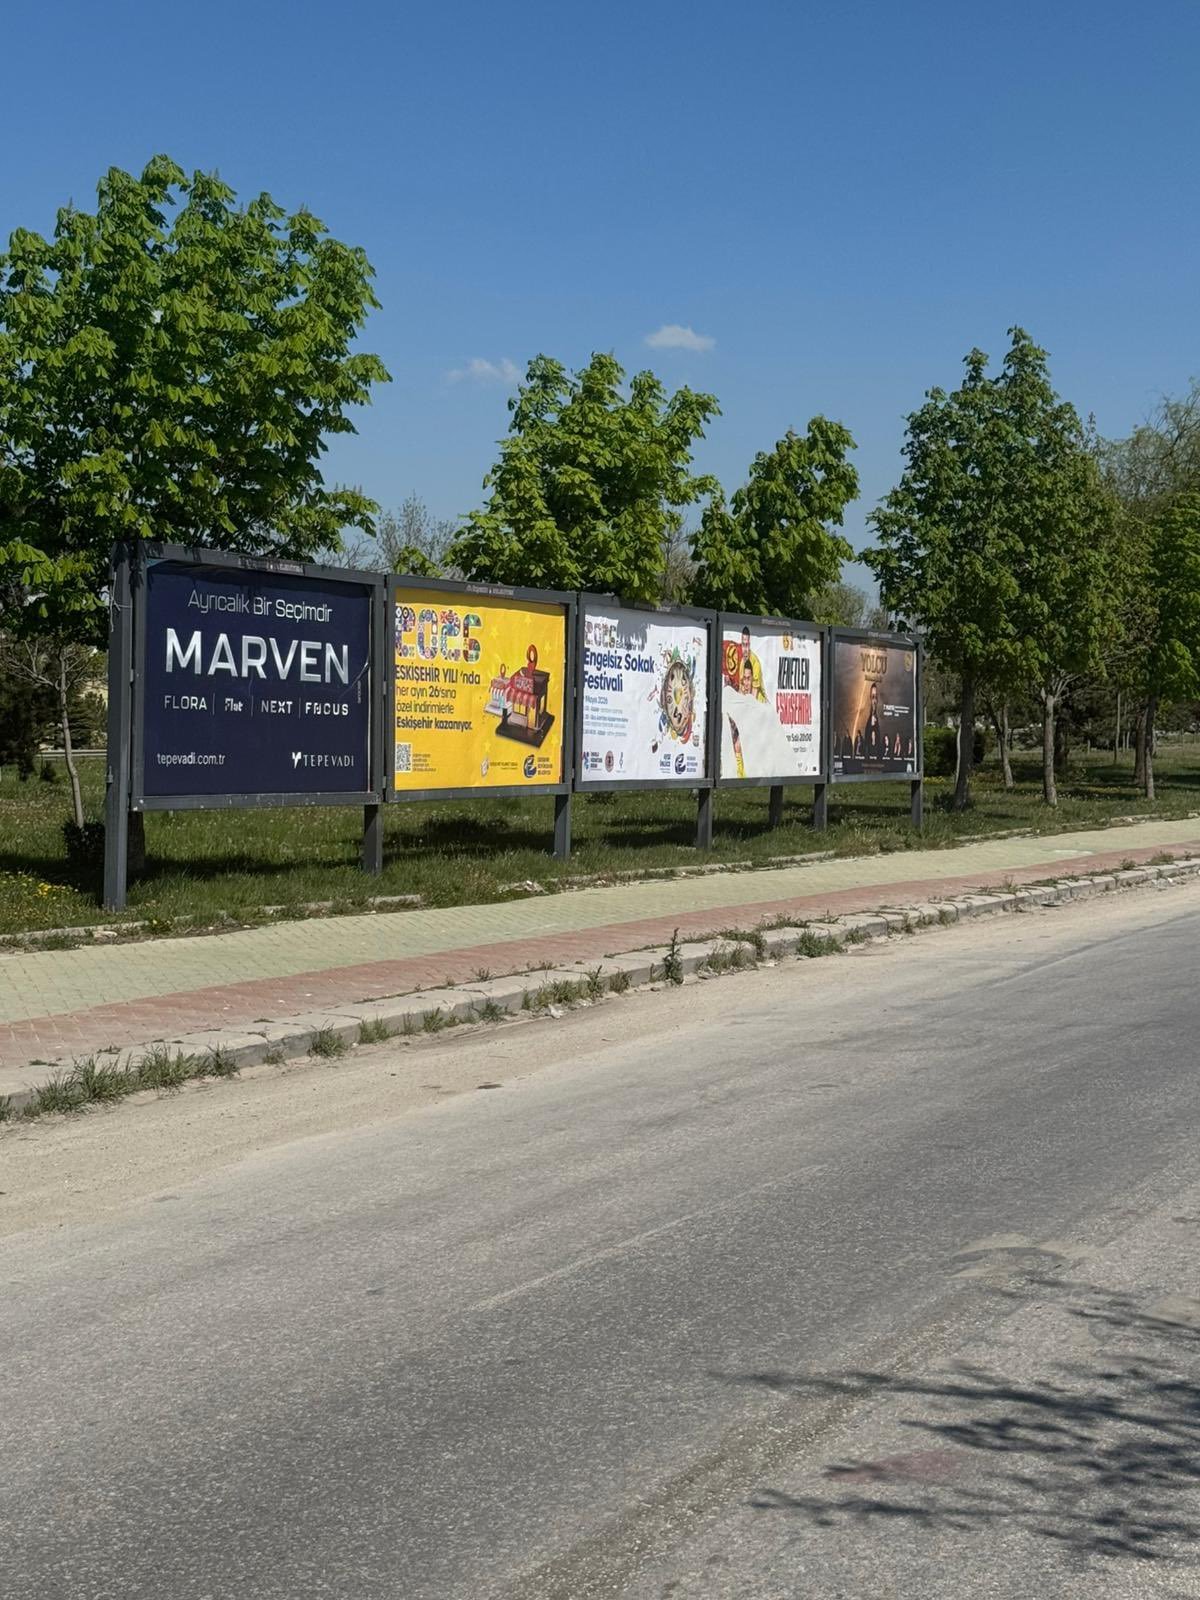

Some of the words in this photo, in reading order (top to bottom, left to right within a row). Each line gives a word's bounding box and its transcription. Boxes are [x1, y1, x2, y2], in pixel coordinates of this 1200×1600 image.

[188, 589, 250, 614] Ayrıcalık
[253, 596, 273, 616] Bir
[275, 599, 333, 623] Seçimdir
[165, 628, 349, 684] MARVEN
[584, 648, 622, 670] Engelsiz
[624, 655, 655, 674] Sokak
[860, 652, 888, 675] YOLCU
[395, 662, 440, 684] ESKİŞEHİR
[442, 668, 458, 683] YILI
[584, 671, 623, 692] Festivali
[396, 685, 409, 697] her
[164, 695, 208, 710] FLORA
[261, 700, 293, 714] NEXT
[397, 715, 433, 731] Eskişehir
[157, 752, 226, 768] tepevadi.com.tr
